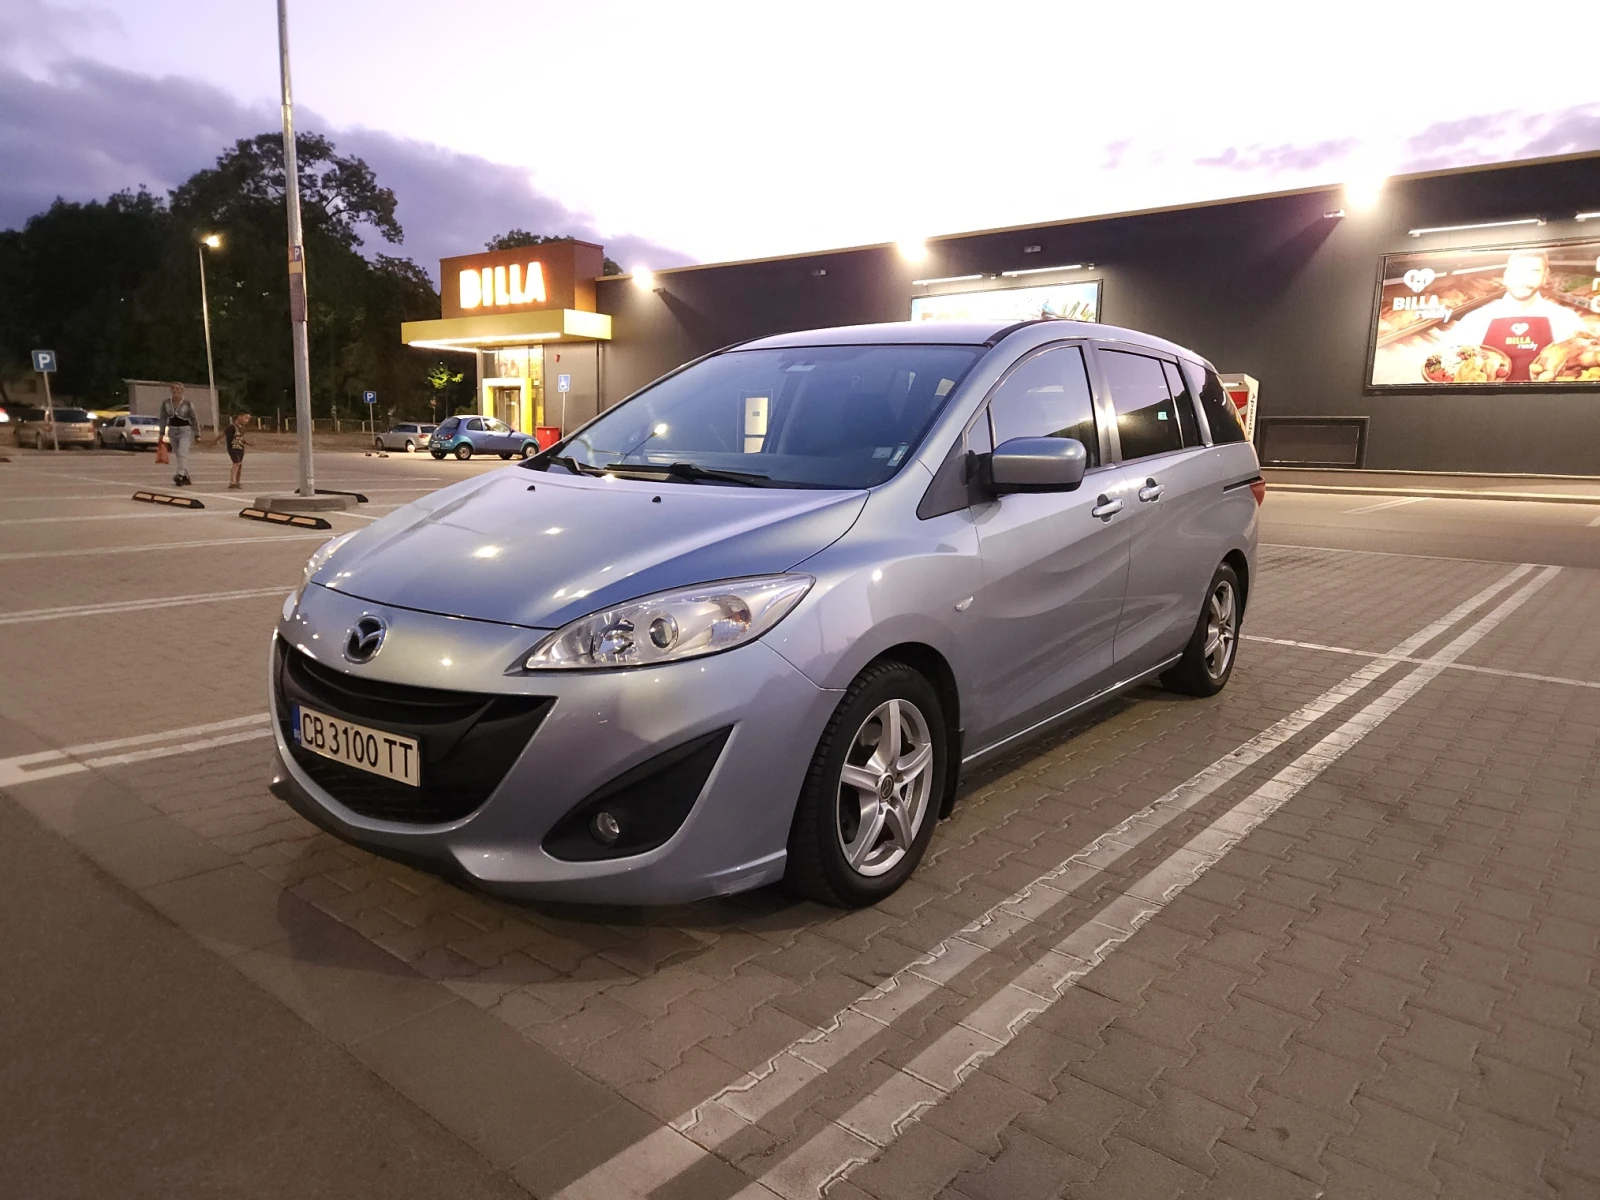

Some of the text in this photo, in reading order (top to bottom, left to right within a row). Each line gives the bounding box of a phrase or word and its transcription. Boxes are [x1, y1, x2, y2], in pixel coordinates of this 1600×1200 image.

[459, 261, 546, 309] BILLA
[1392, 295, 1439, 311] BILLA
[38, 353, 50, 369] P
[366, 392, 374, 402] P
[328, 722, 378, 767] 3100
[383, 737, 413, 778] TT
